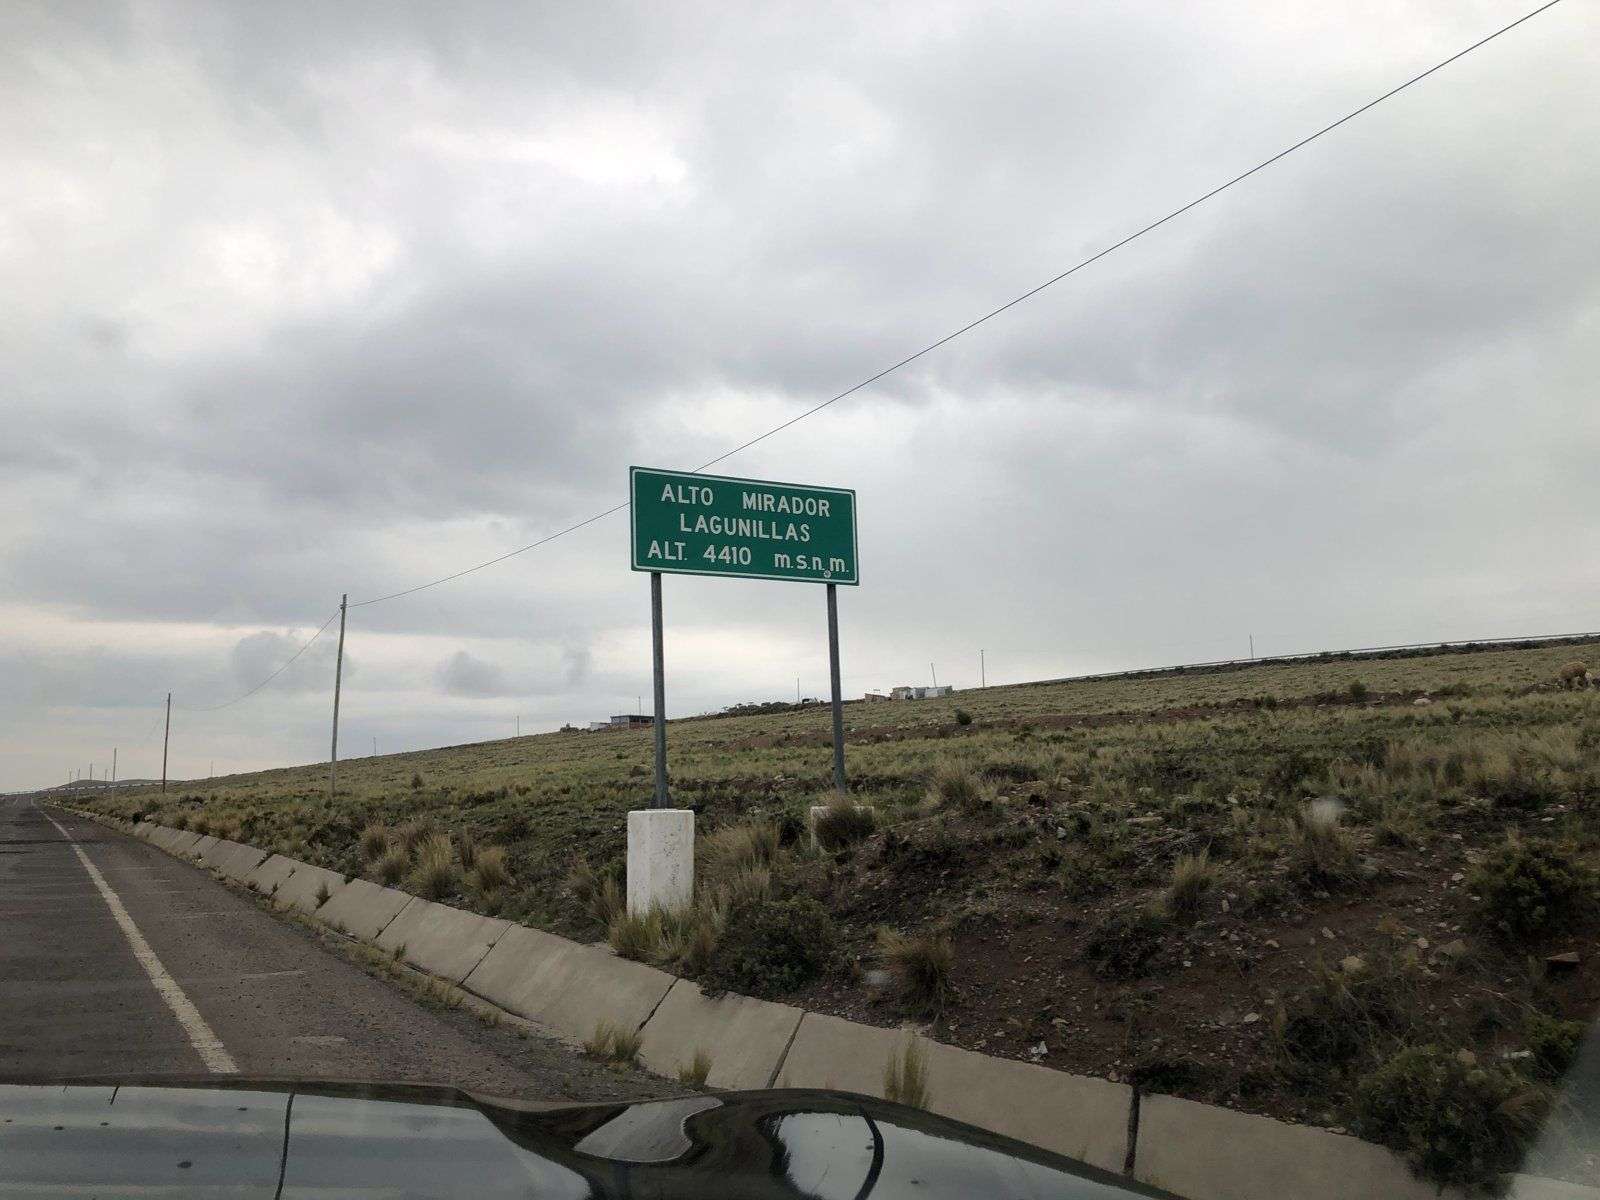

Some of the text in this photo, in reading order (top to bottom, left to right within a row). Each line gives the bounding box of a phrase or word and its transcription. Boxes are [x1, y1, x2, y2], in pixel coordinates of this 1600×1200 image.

[661, 483, 830, 517] ALTO MIRADOR
[680, 513, 810, 542] LAGUNILLAS
[647, 540, 687, 561] ALT.
[703, 544, 752, 565] 4410
